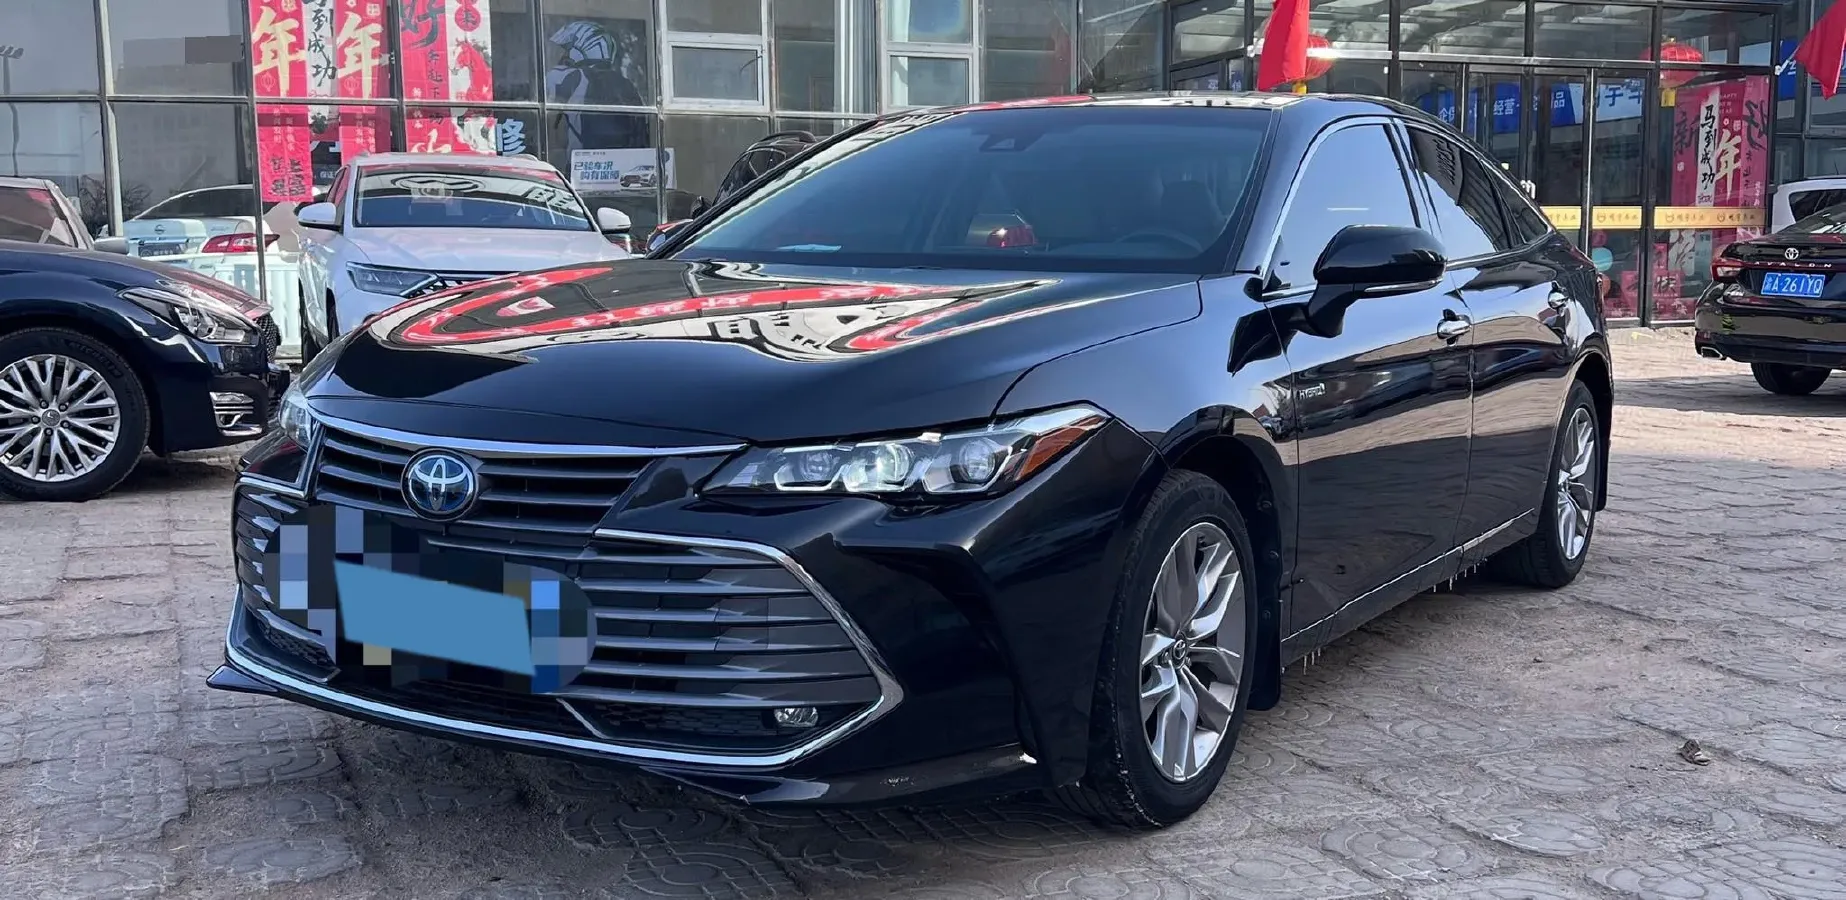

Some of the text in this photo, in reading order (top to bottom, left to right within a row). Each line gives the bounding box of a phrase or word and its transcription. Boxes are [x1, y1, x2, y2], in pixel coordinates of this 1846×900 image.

[251, 6, 306, 98] 年
[336, 11, 388, 100] 年
[495, 118, 527, 156] 修
[1700, 104, 1716, 190] 马到成功
[1715, 128, 1743, 204] 年
